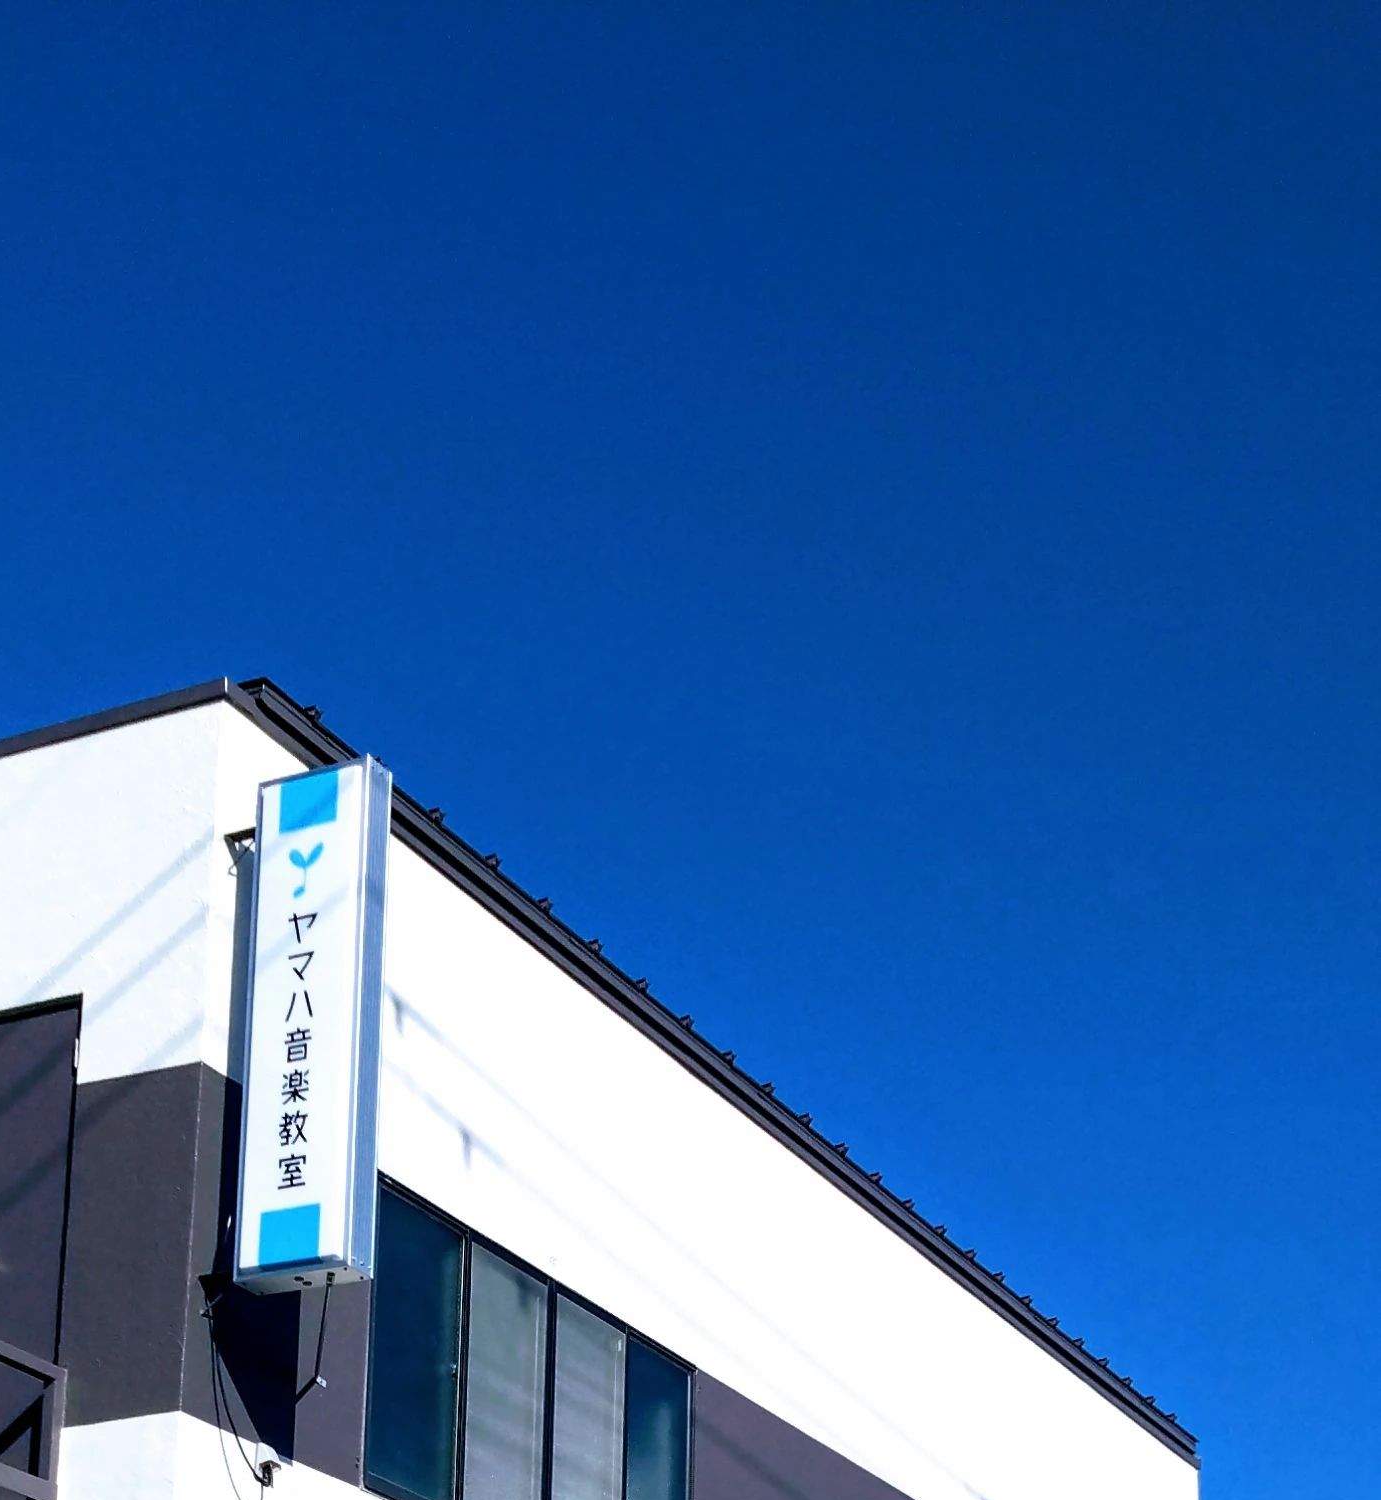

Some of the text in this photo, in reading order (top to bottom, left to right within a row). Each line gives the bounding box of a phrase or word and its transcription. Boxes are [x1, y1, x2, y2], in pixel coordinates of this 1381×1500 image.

[278, 910, 318, 1190] ヤマハ音楽教室
